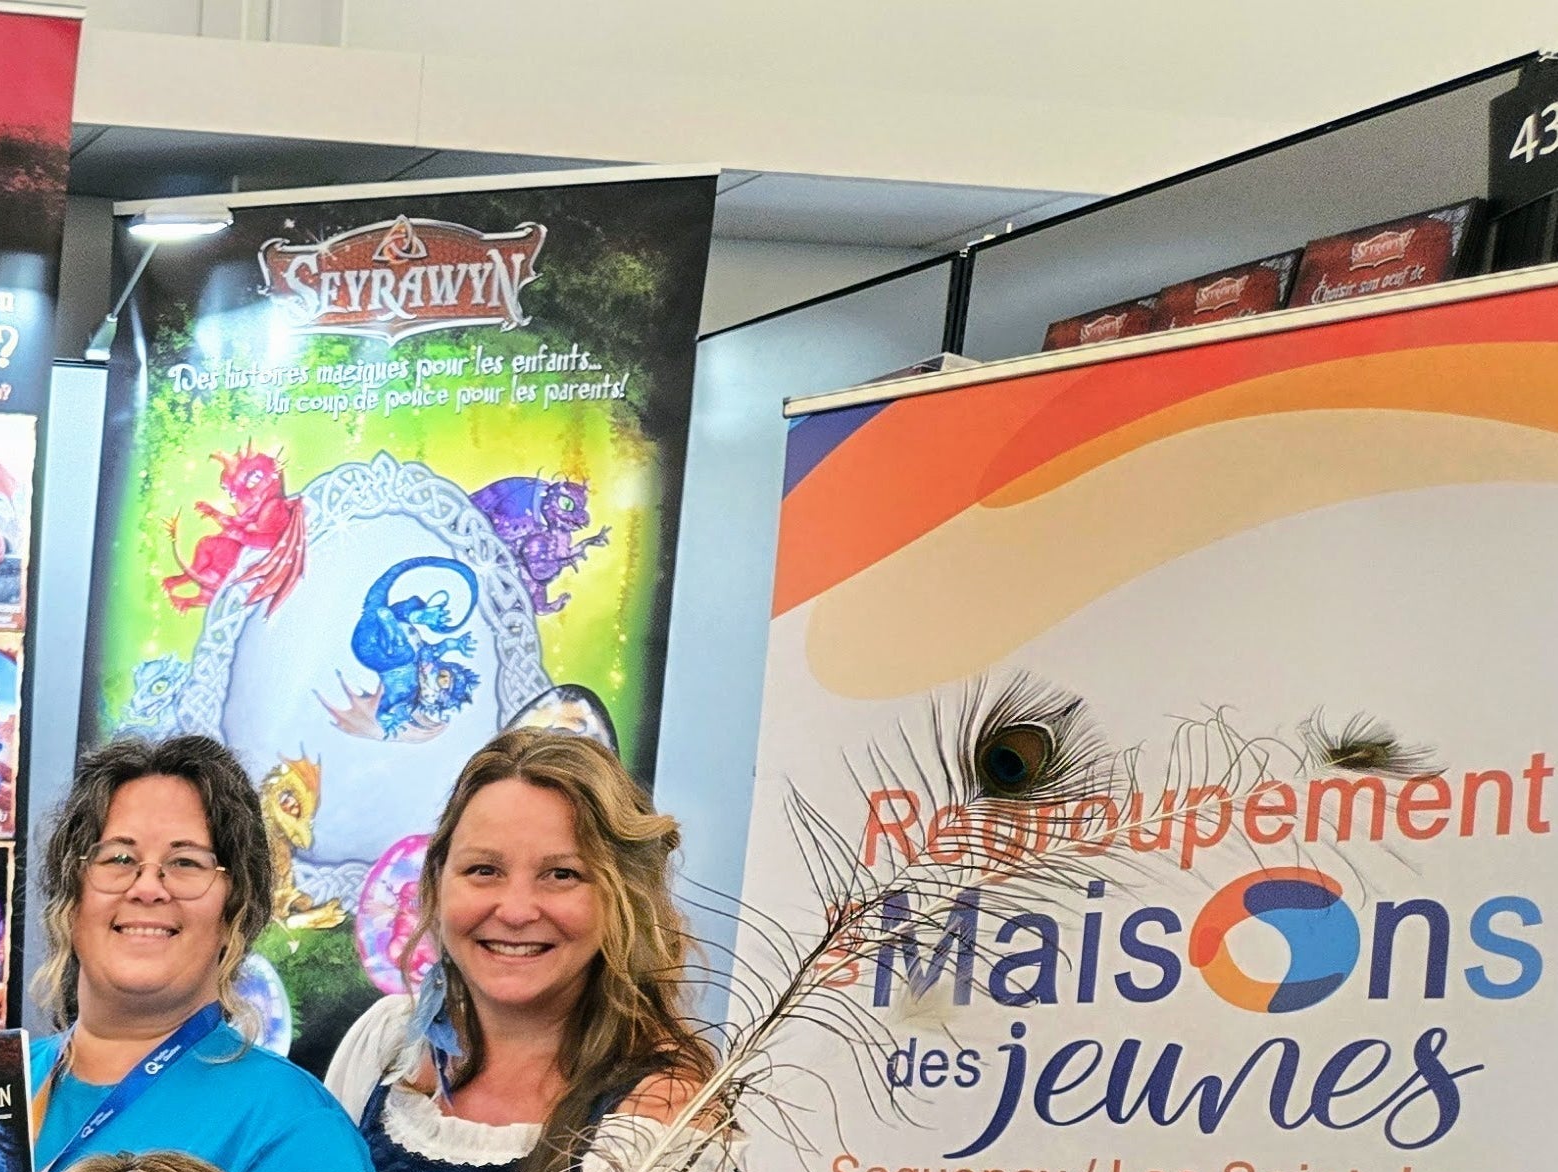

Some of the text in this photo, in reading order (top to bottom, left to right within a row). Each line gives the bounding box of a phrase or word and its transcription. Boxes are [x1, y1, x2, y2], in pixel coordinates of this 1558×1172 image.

[168, 363, 218, 392] Des
[225, 359, 309, 389] histoires
[317, 359, 408, 394] magiques
[417, 357, 469, 387] pour
[475, 345, 503, 375] les
[266, 373, 629, 420] Un coup de pouce pour les parents!
[864, 753, 1555, 883] Regroupement
[886, 1021, 1484, 1159] des jeunes
